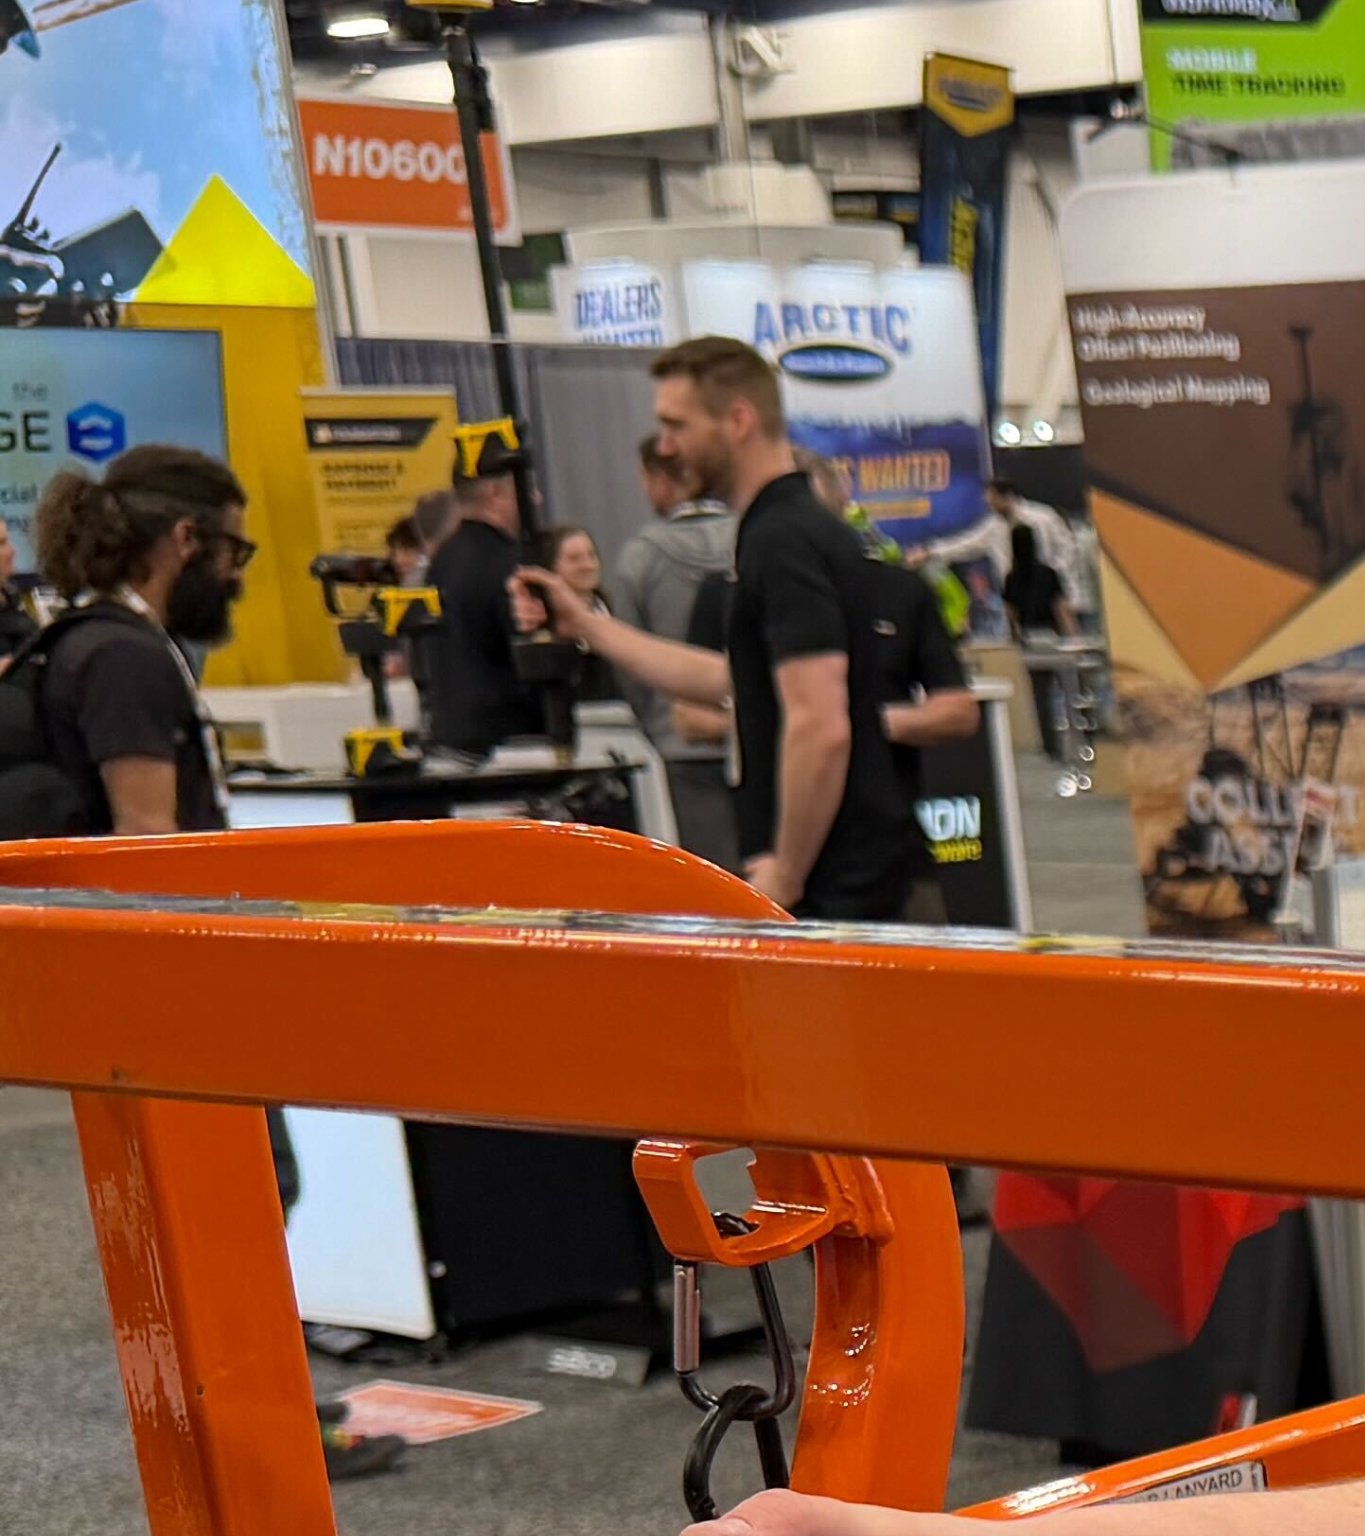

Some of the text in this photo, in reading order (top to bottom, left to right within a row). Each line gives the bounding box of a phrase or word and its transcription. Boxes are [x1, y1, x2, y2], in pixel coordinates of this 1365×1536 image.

[1174, 73, 1345, 97] TIME TRACKING
[314, 133, 467, 185] N10600
[754, 302, 913, 356] ARCTIC
[1186, 374, 1271, 406] Mapping
[858, 451, 951, 492] WANTED
